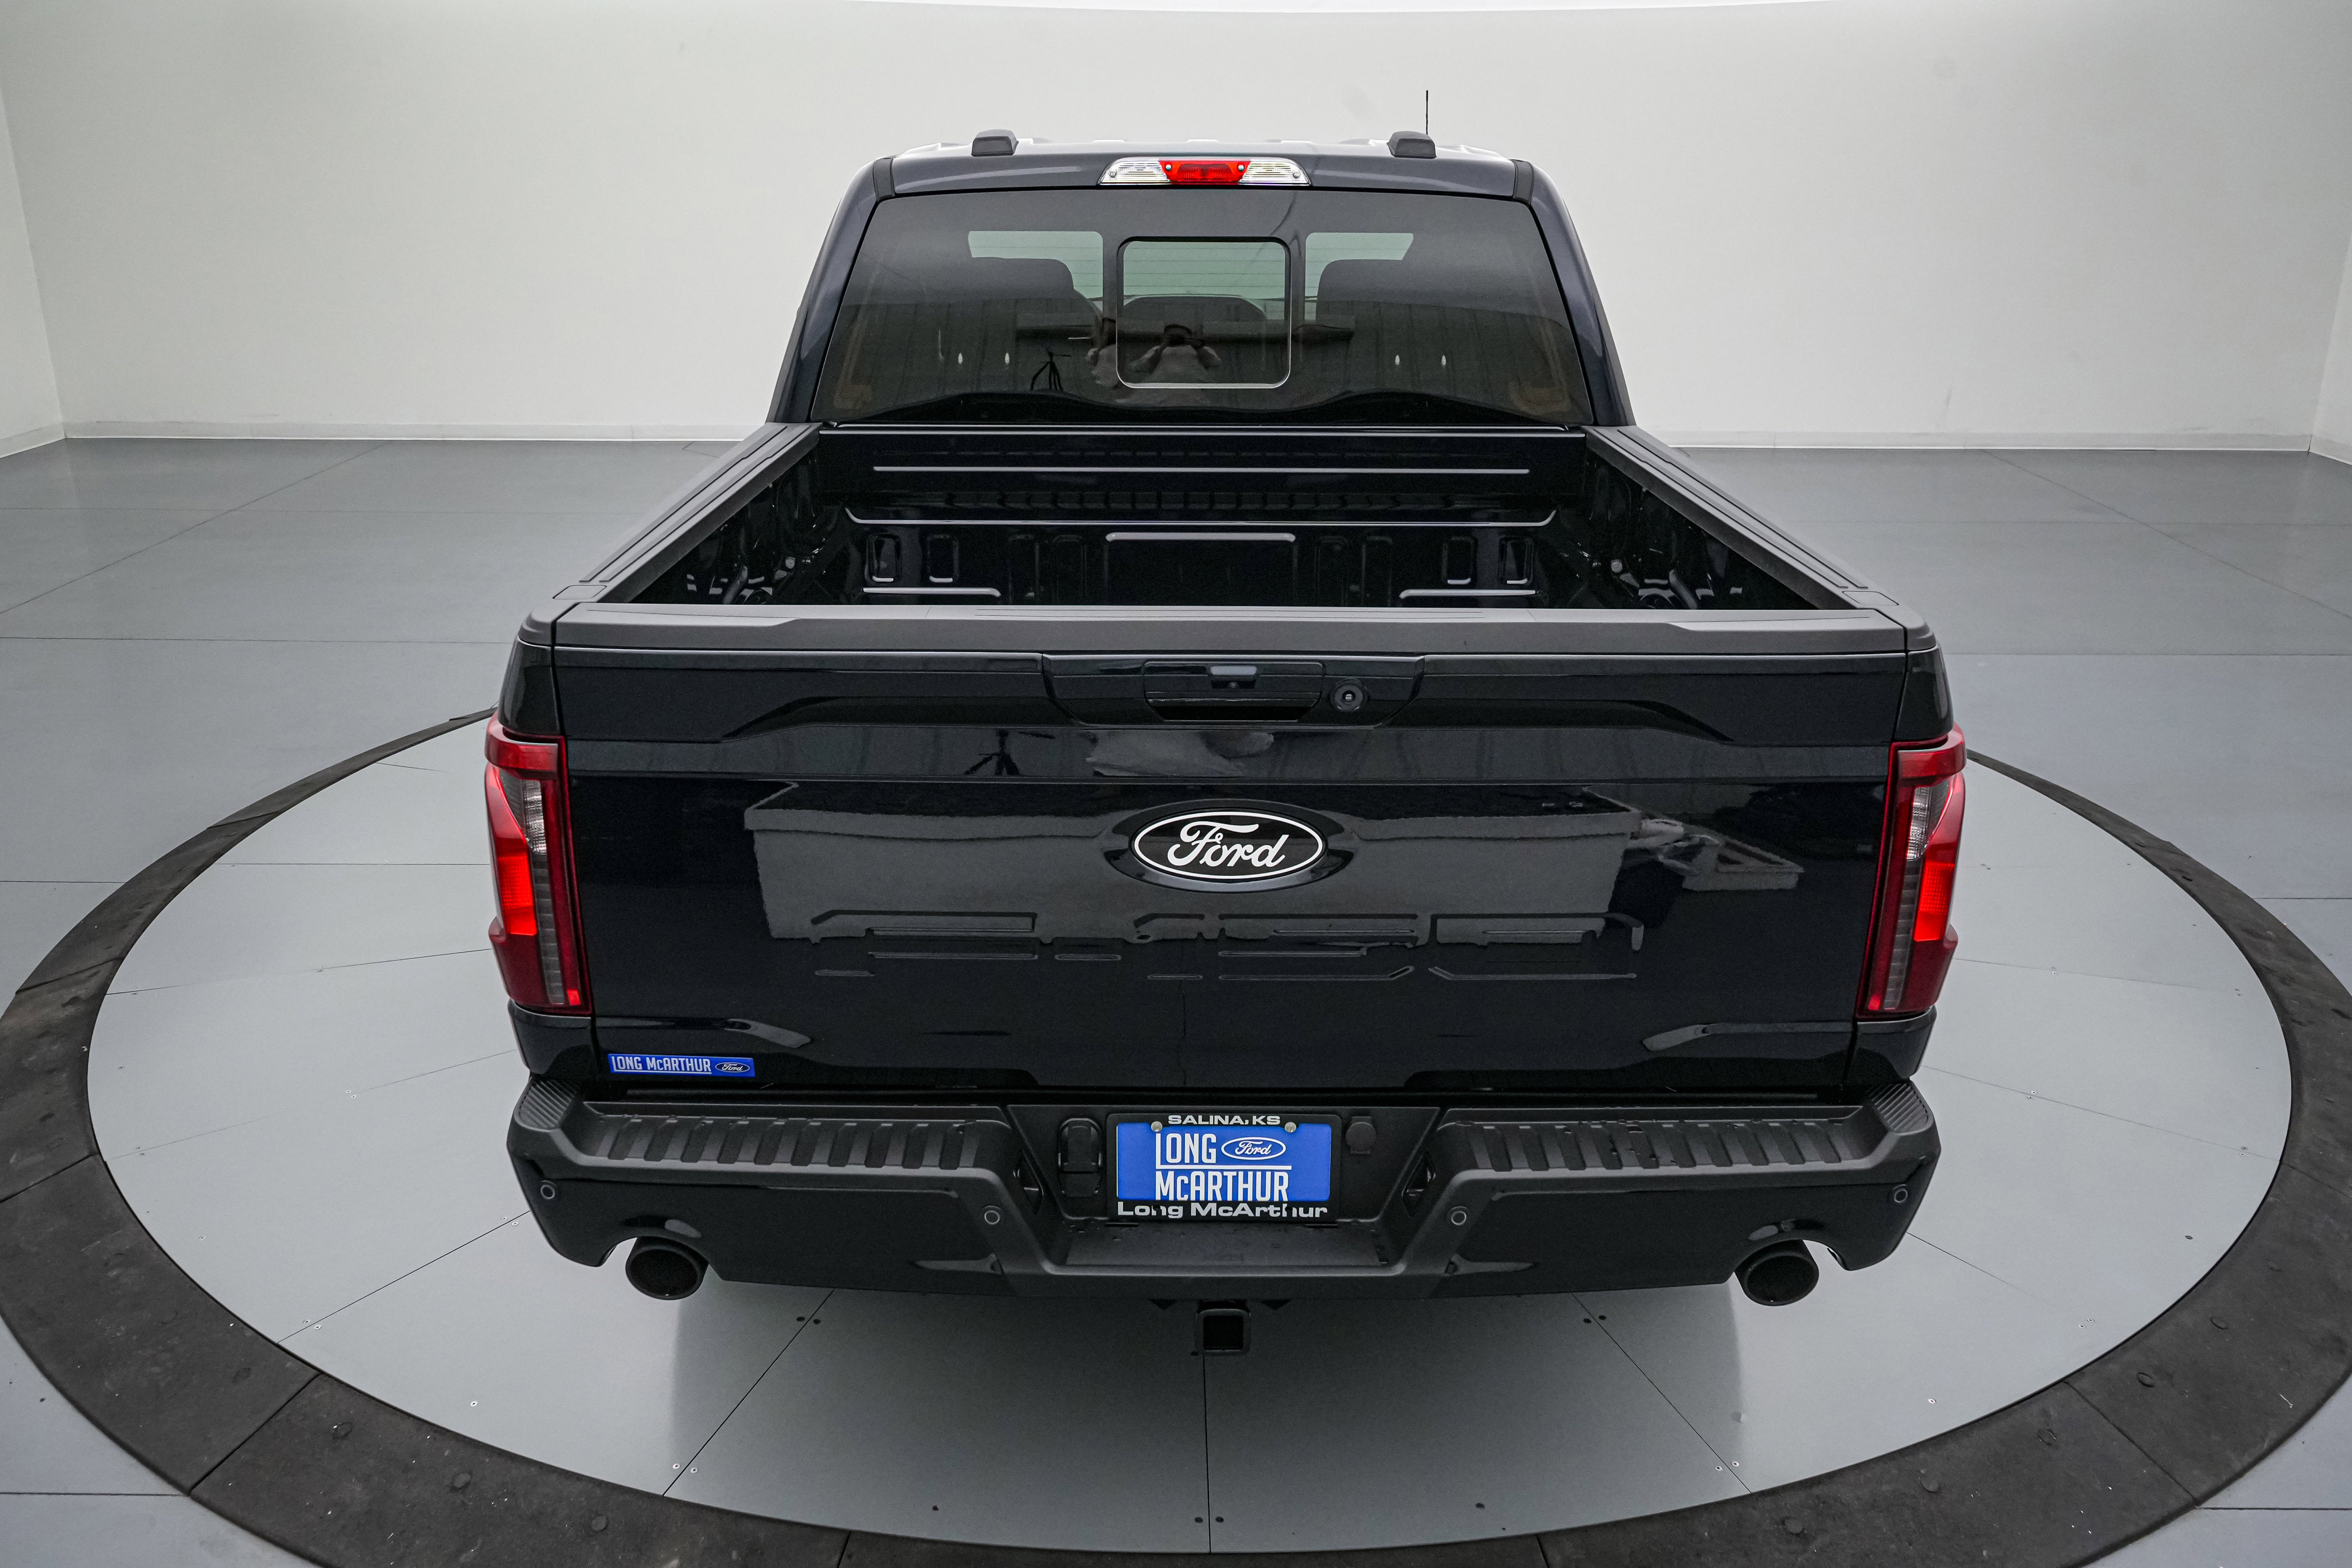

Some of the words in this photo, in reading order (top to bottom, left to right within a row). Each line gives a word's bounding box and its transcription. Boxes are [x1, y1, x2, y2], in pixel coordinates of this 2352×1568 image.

[1167, 821, 1289, 867] Ford
[612, 1056, 643, 1072] LONG
[646, 1057, 711, 1072] McARTHUR
[1252, 1116, 1281, 1125] KS
[1156, 1133, 1216, 1169] LONG
[1235, 1141, 1272, 1155] Ford
[1156, 1171, 1289, 1201] McARTHUR
[1118, 1201, 1183, 1218] Long
[1191, 1203, 1327, 1217] McArthur
